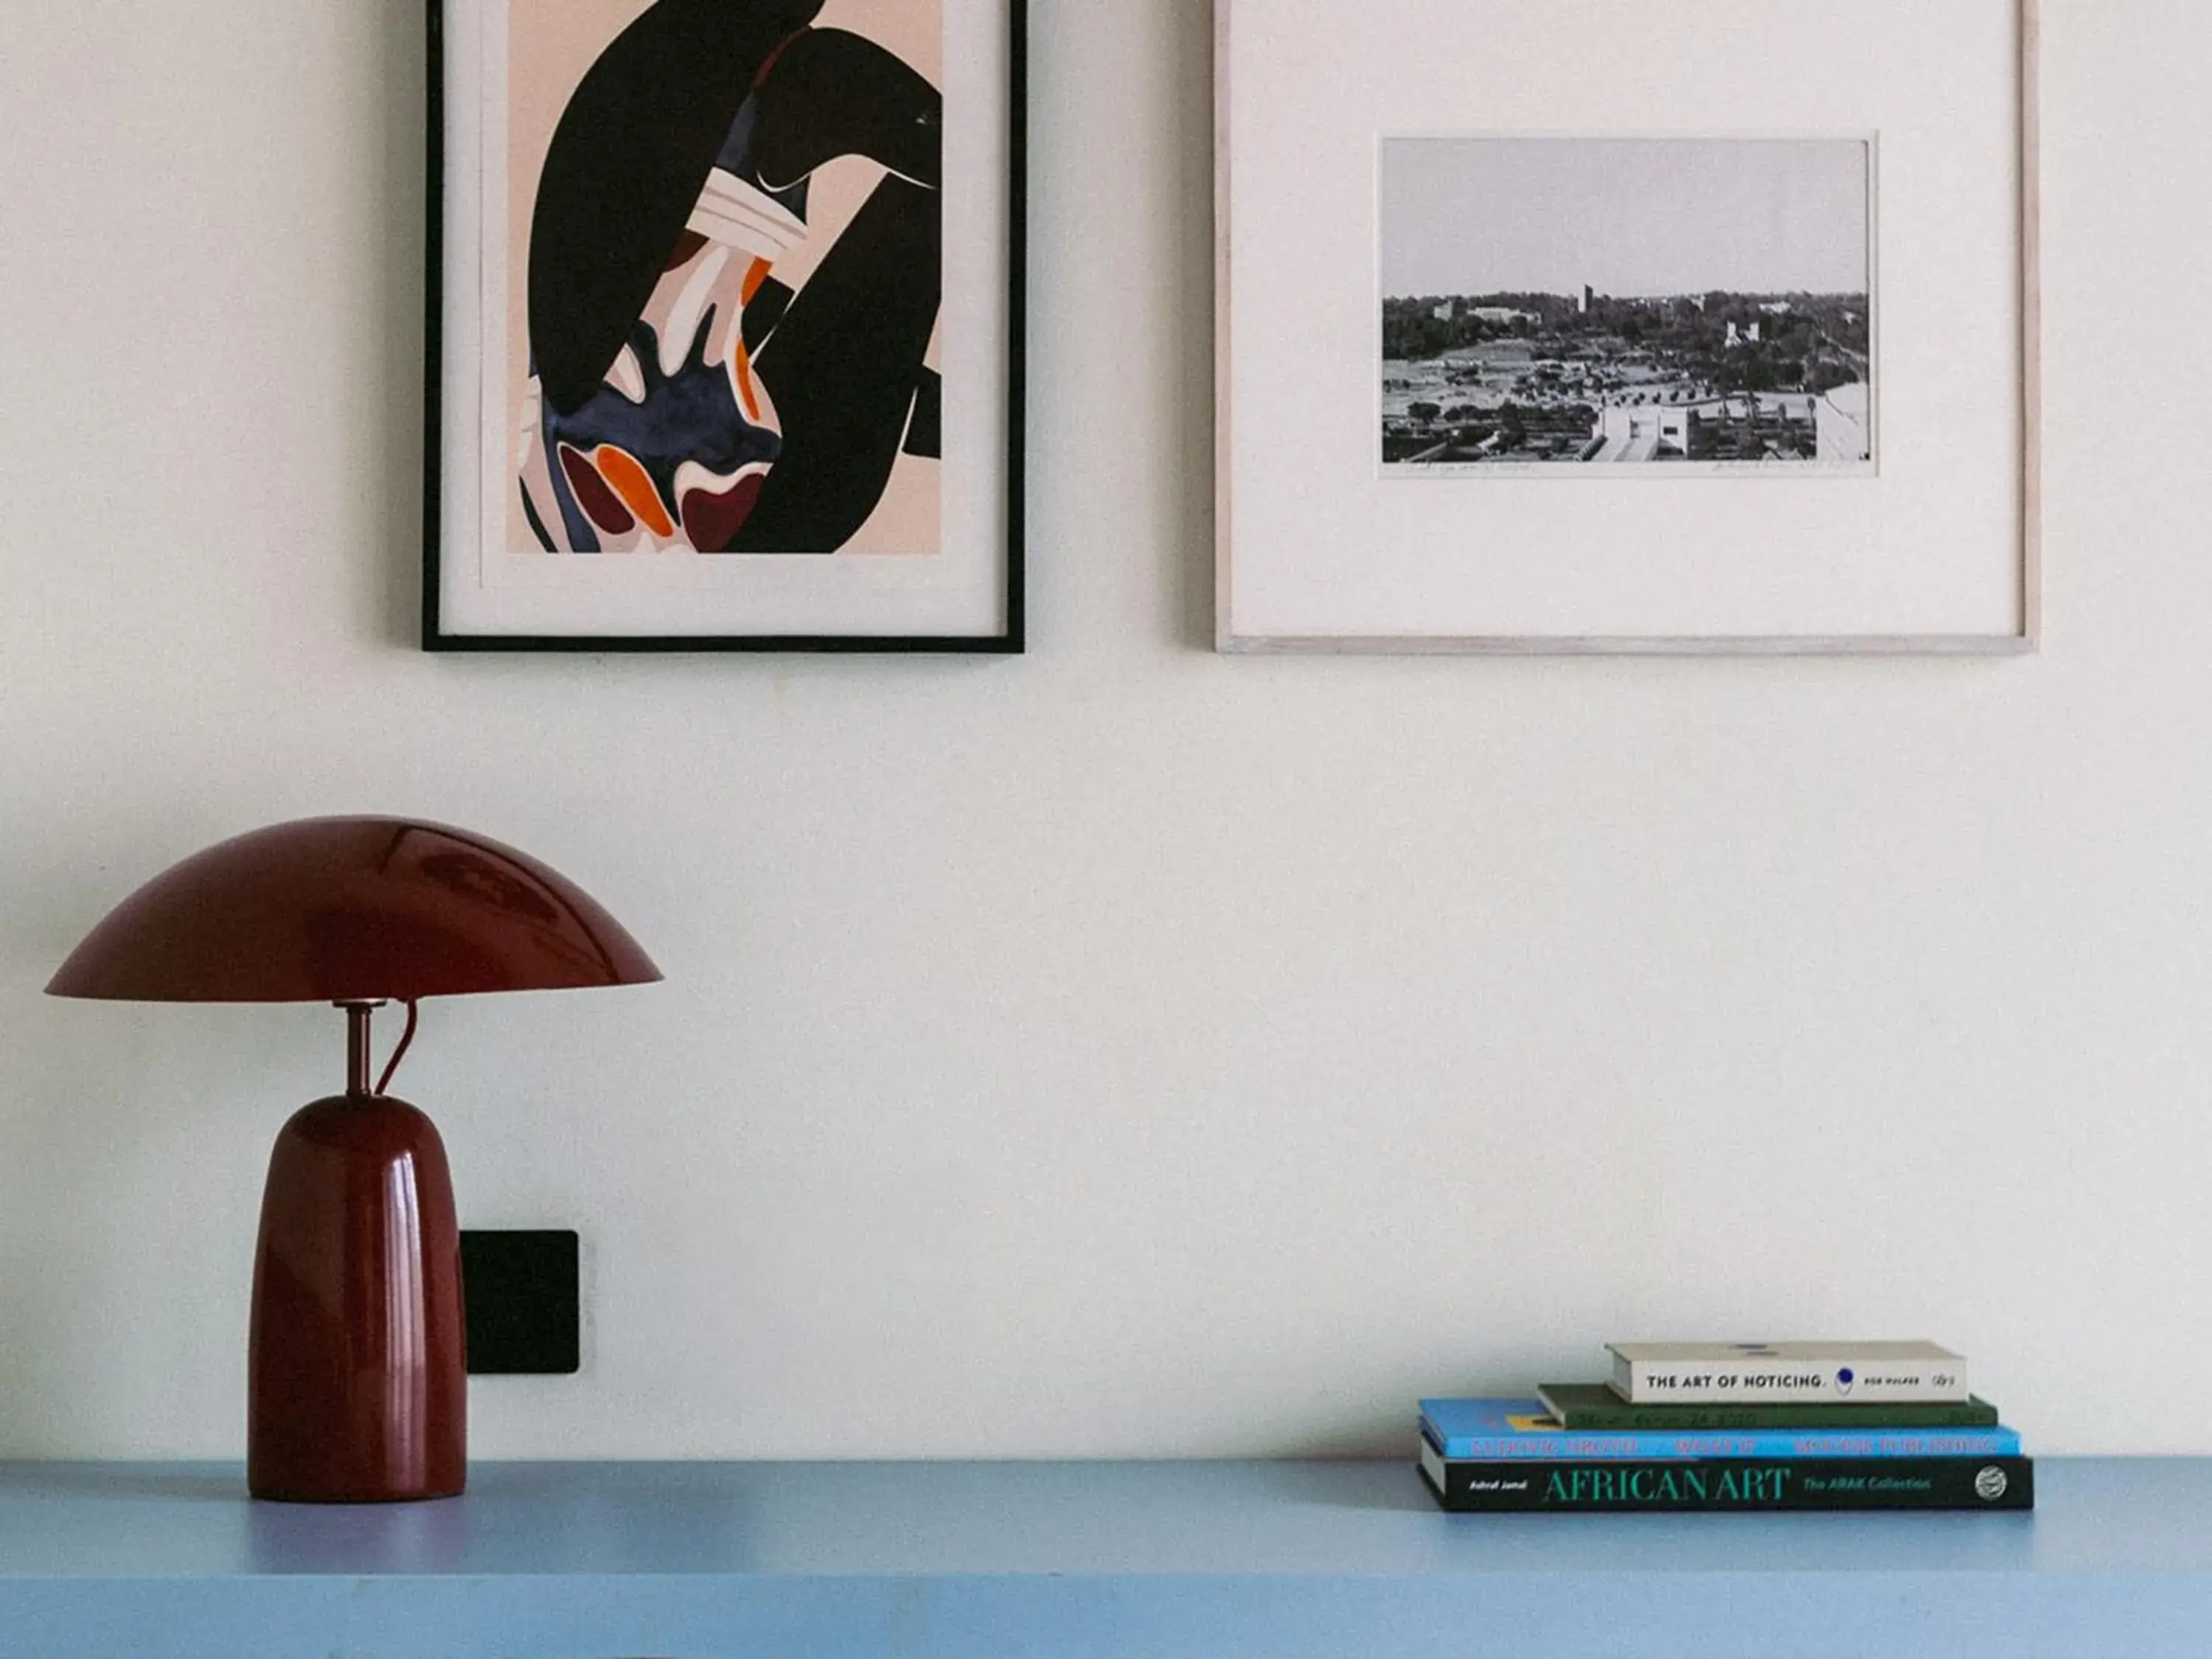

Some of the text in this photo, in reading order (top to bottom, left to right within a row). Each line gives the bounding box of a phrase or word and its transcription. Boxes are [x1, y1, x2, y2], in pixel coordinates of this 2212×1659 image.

[1646, 1375, 1677, 1388] THE
[1682, 1375, 1712, 1388] ART
[1717, 1375, 1737, 1388] OF
[1543, 1468, 1792, 1501] AFRICAN ART
[1804, 1478, 1825, 1489] The
[1868, 1478, 1932, 1489] Collection
